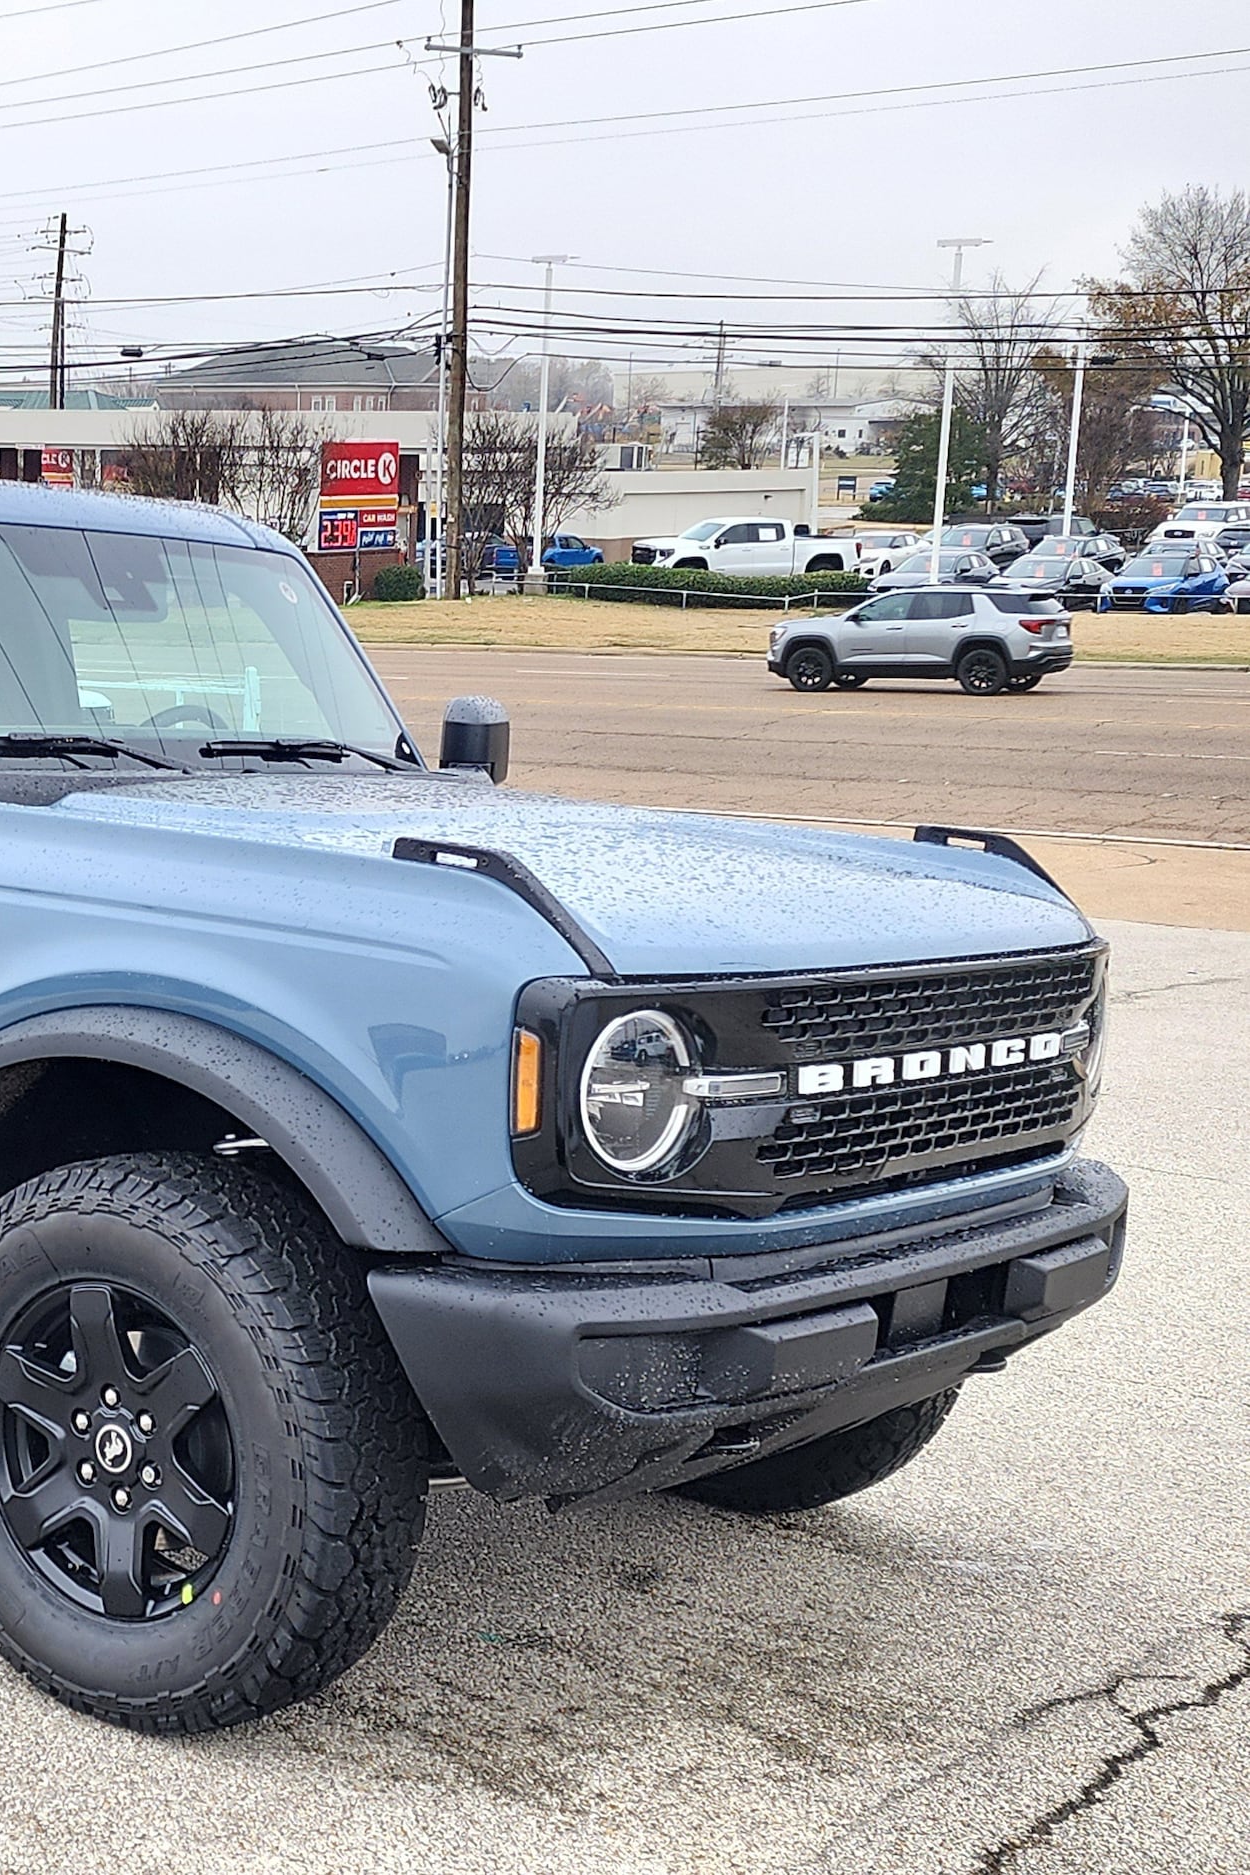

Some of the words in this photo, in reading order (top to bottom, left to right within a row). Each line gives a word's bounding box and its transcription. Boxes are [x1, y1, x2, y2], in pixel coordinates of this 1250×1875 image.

[326, 459, 376, 480] CIRCLE
[379, 453, 396, 484] K
[798, 1032, 1062, 1095] BRONCO
